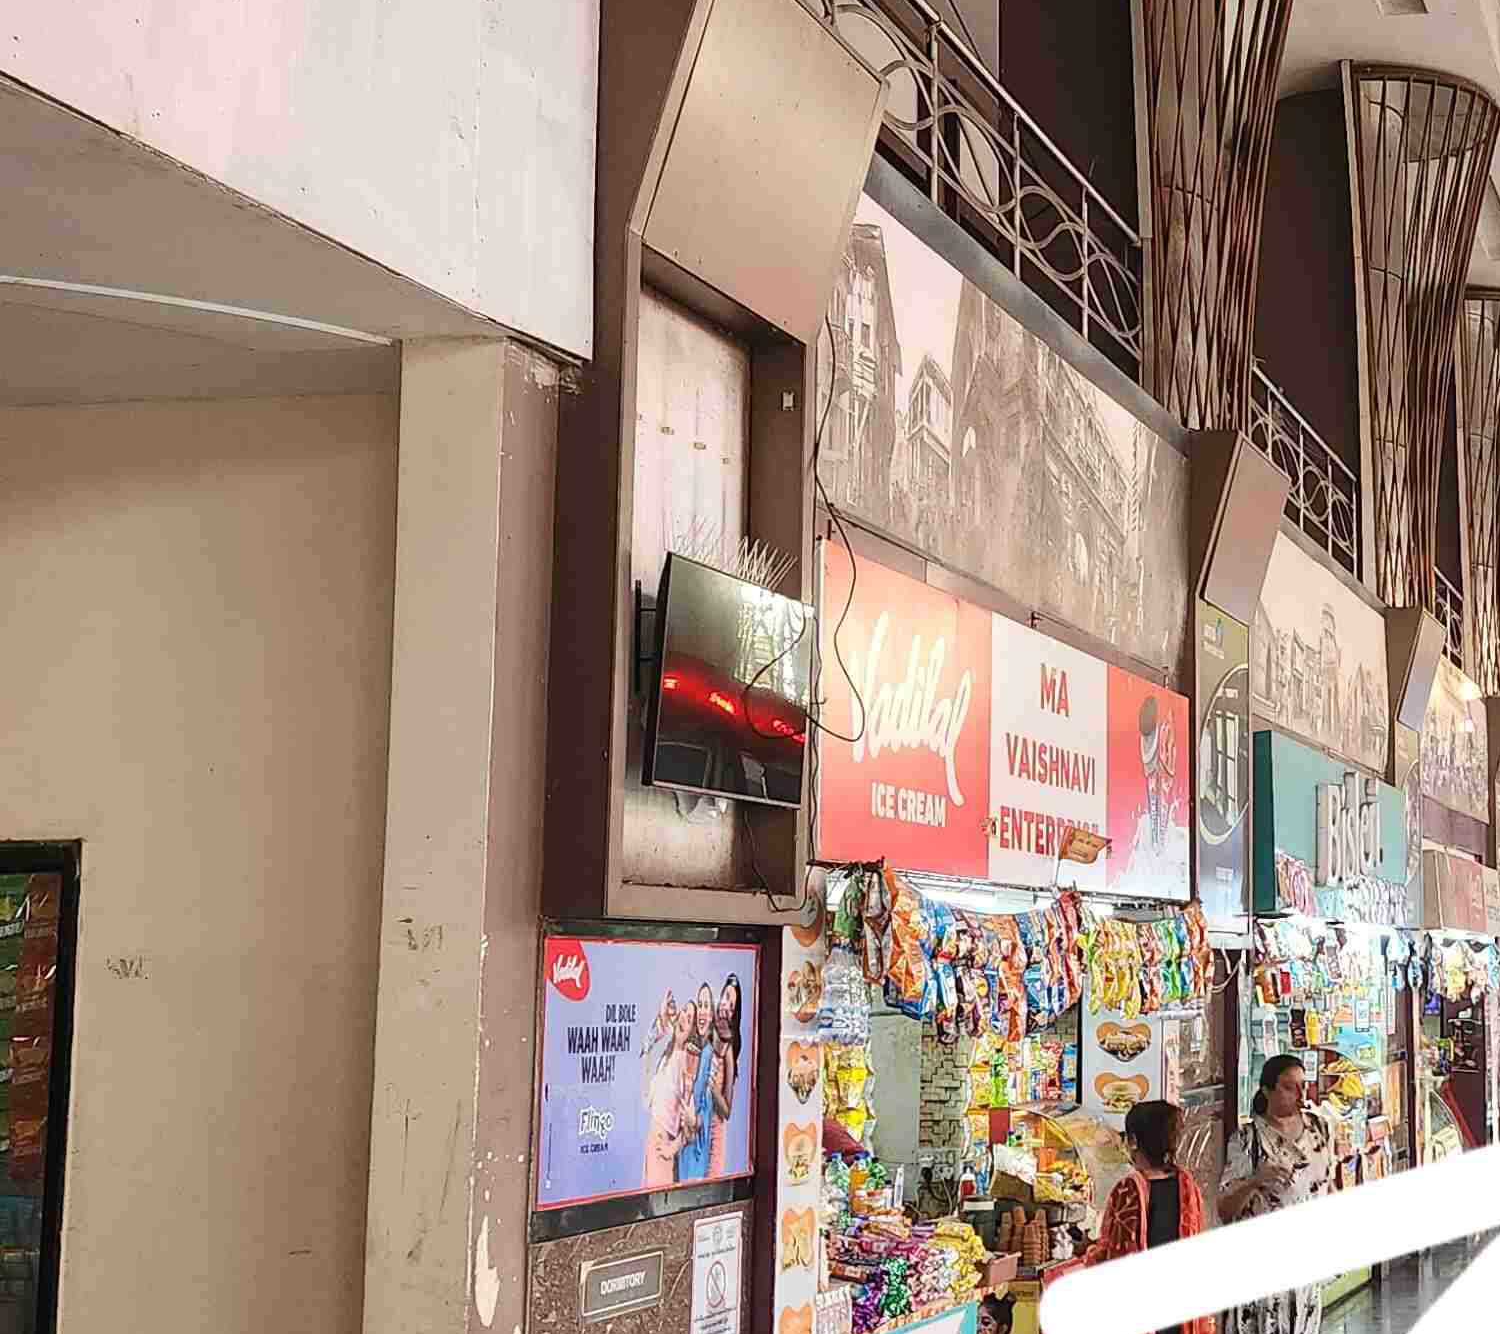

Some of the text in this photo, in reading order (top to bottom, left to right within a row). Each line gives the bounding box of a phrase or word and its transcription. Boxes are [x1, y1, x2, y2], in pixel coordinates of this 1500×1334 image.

[1040, 663, 1069, 717] MA
[1005, 732, 1096, 795] VAISHNAVI
[872, 782, 947, 827] ICE CREAM
[1000, 805, 1099, 858] ENTERP
[605, 1004, 636, 1023] DIL BOLE
[567, 1025, 631, 1054] WAAH WAAH
[581, 1056, 615, 1083] WAAH!
